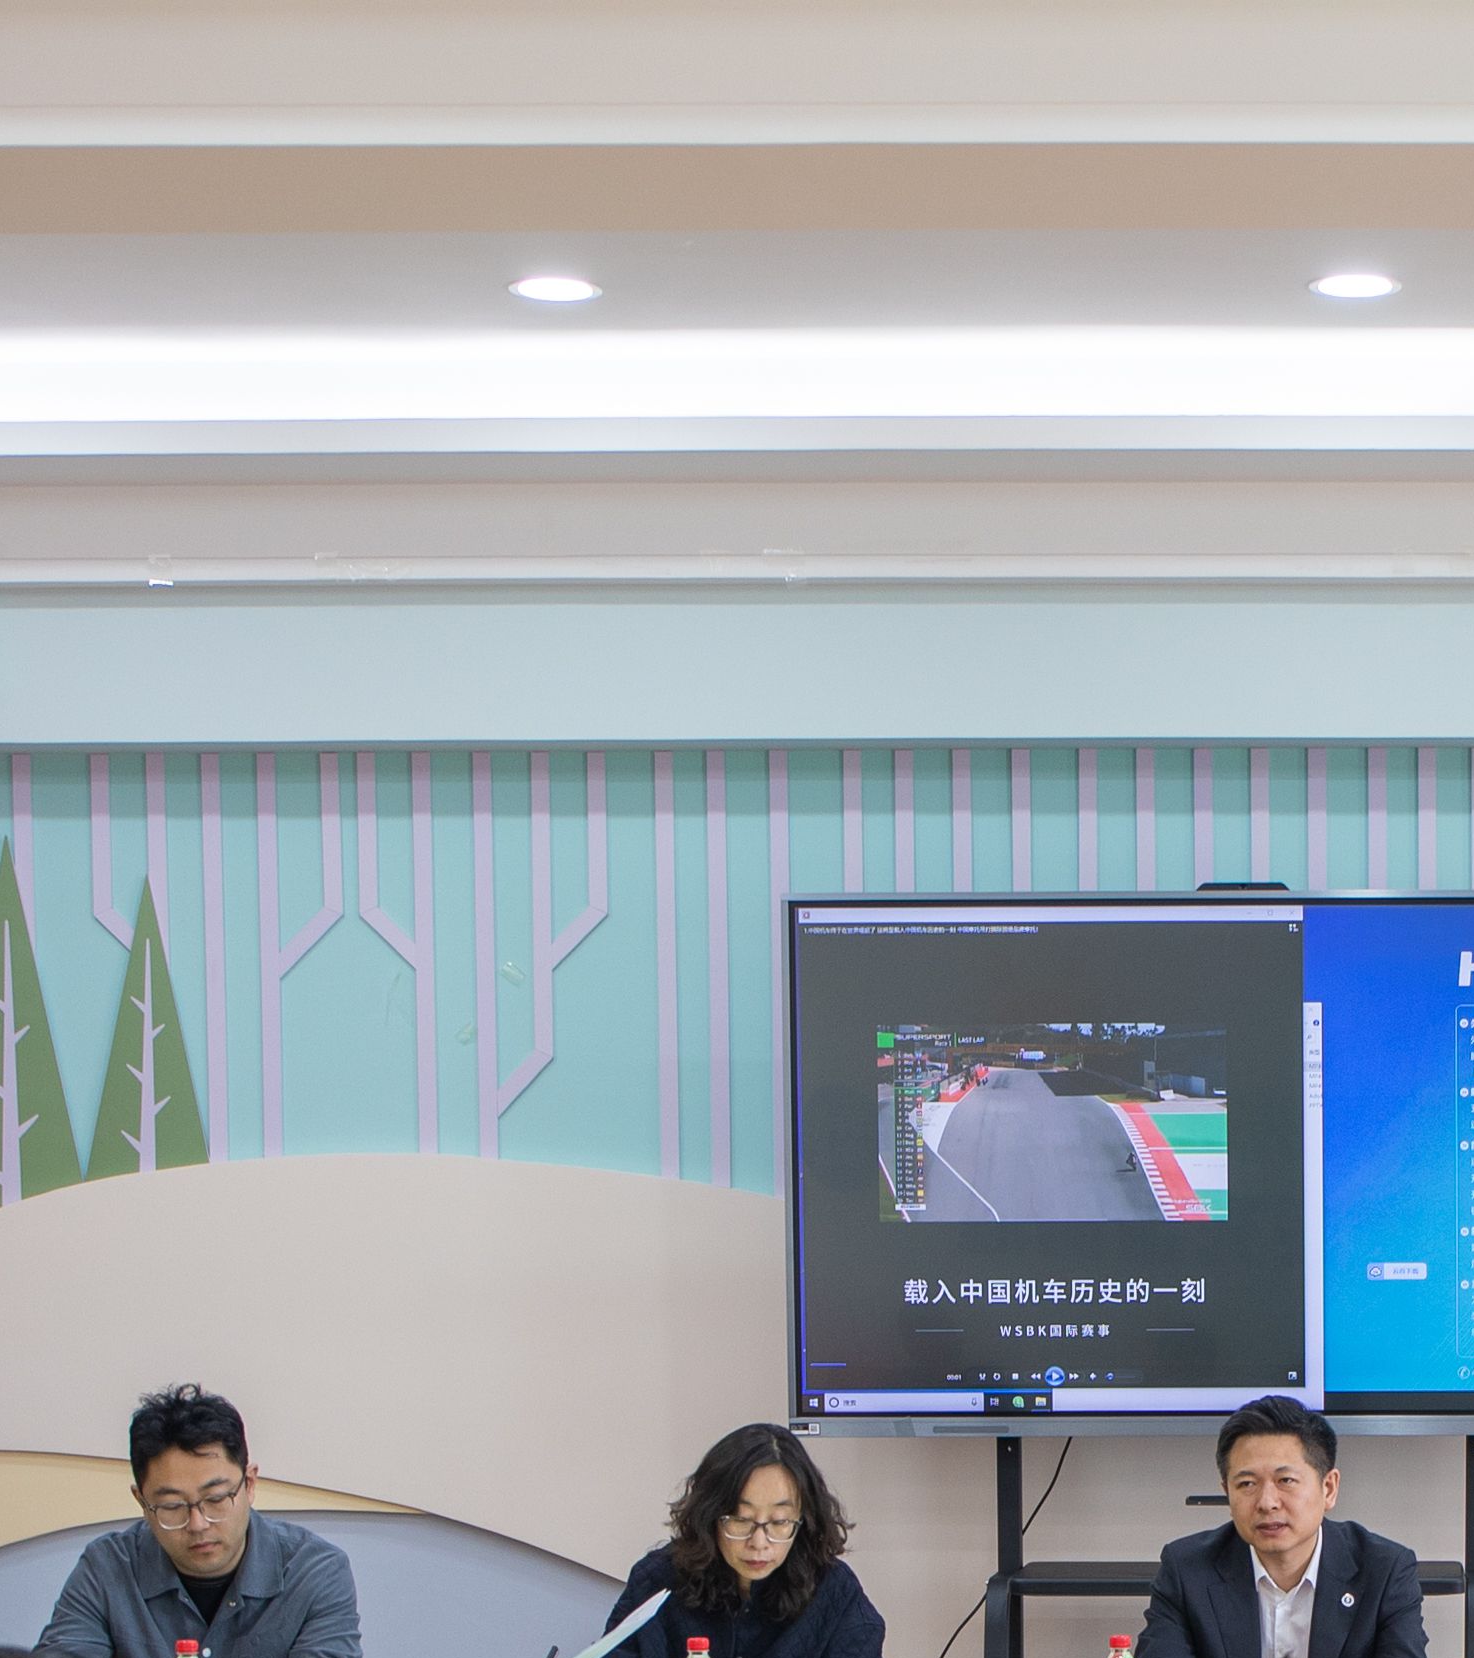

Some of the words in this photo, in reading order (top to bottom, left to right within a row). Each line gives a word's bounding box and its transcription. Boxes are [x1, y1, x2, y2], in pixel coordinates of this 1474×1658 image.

[903, 1278, 1206, 1305] 载入中国机车历史的一刻
[1000, 1324, 1111, 1339] WSBK国际赛事
